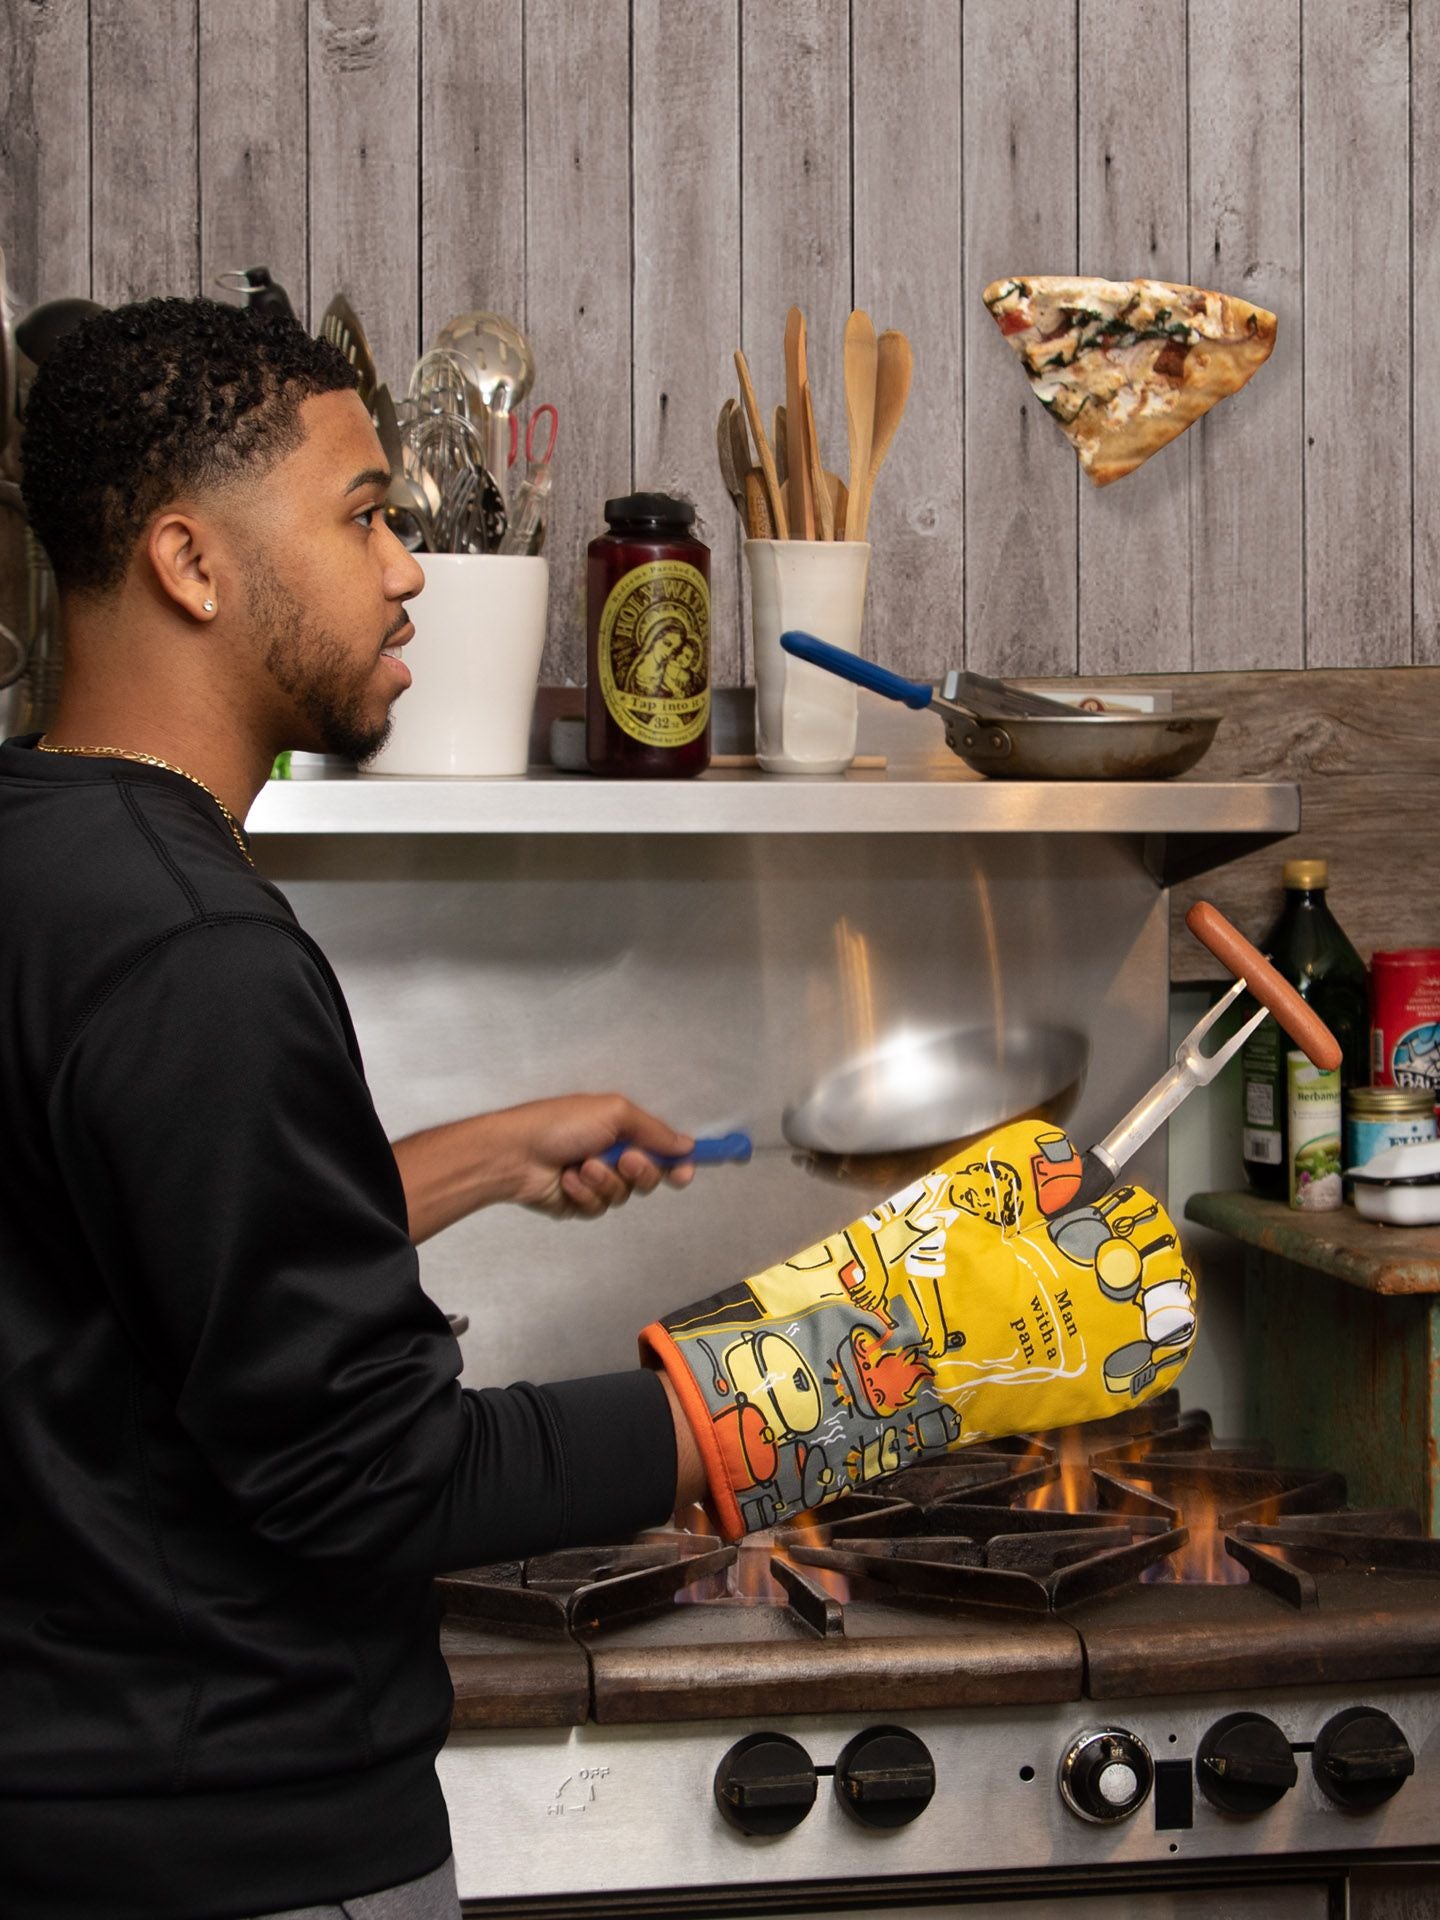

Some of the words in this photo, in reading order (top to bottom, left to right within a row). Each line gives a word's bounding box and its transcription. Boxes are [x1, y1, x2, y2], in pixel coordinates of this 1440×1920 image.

[614, 582, 656, 638] HOLY
[631, 697, 656, 711] Tap
[662, 701, 688, 711] into
[654, 717, 669, 728] 32
[1030, 1295, 1055, 1344] with
[1046, 1347, 1057, 1360] a
[1054, 1288, 1078, 1338] Man
[1010, 1316, 1035, 1364] pan.
[579, 1766, 610, 1780] OFF
